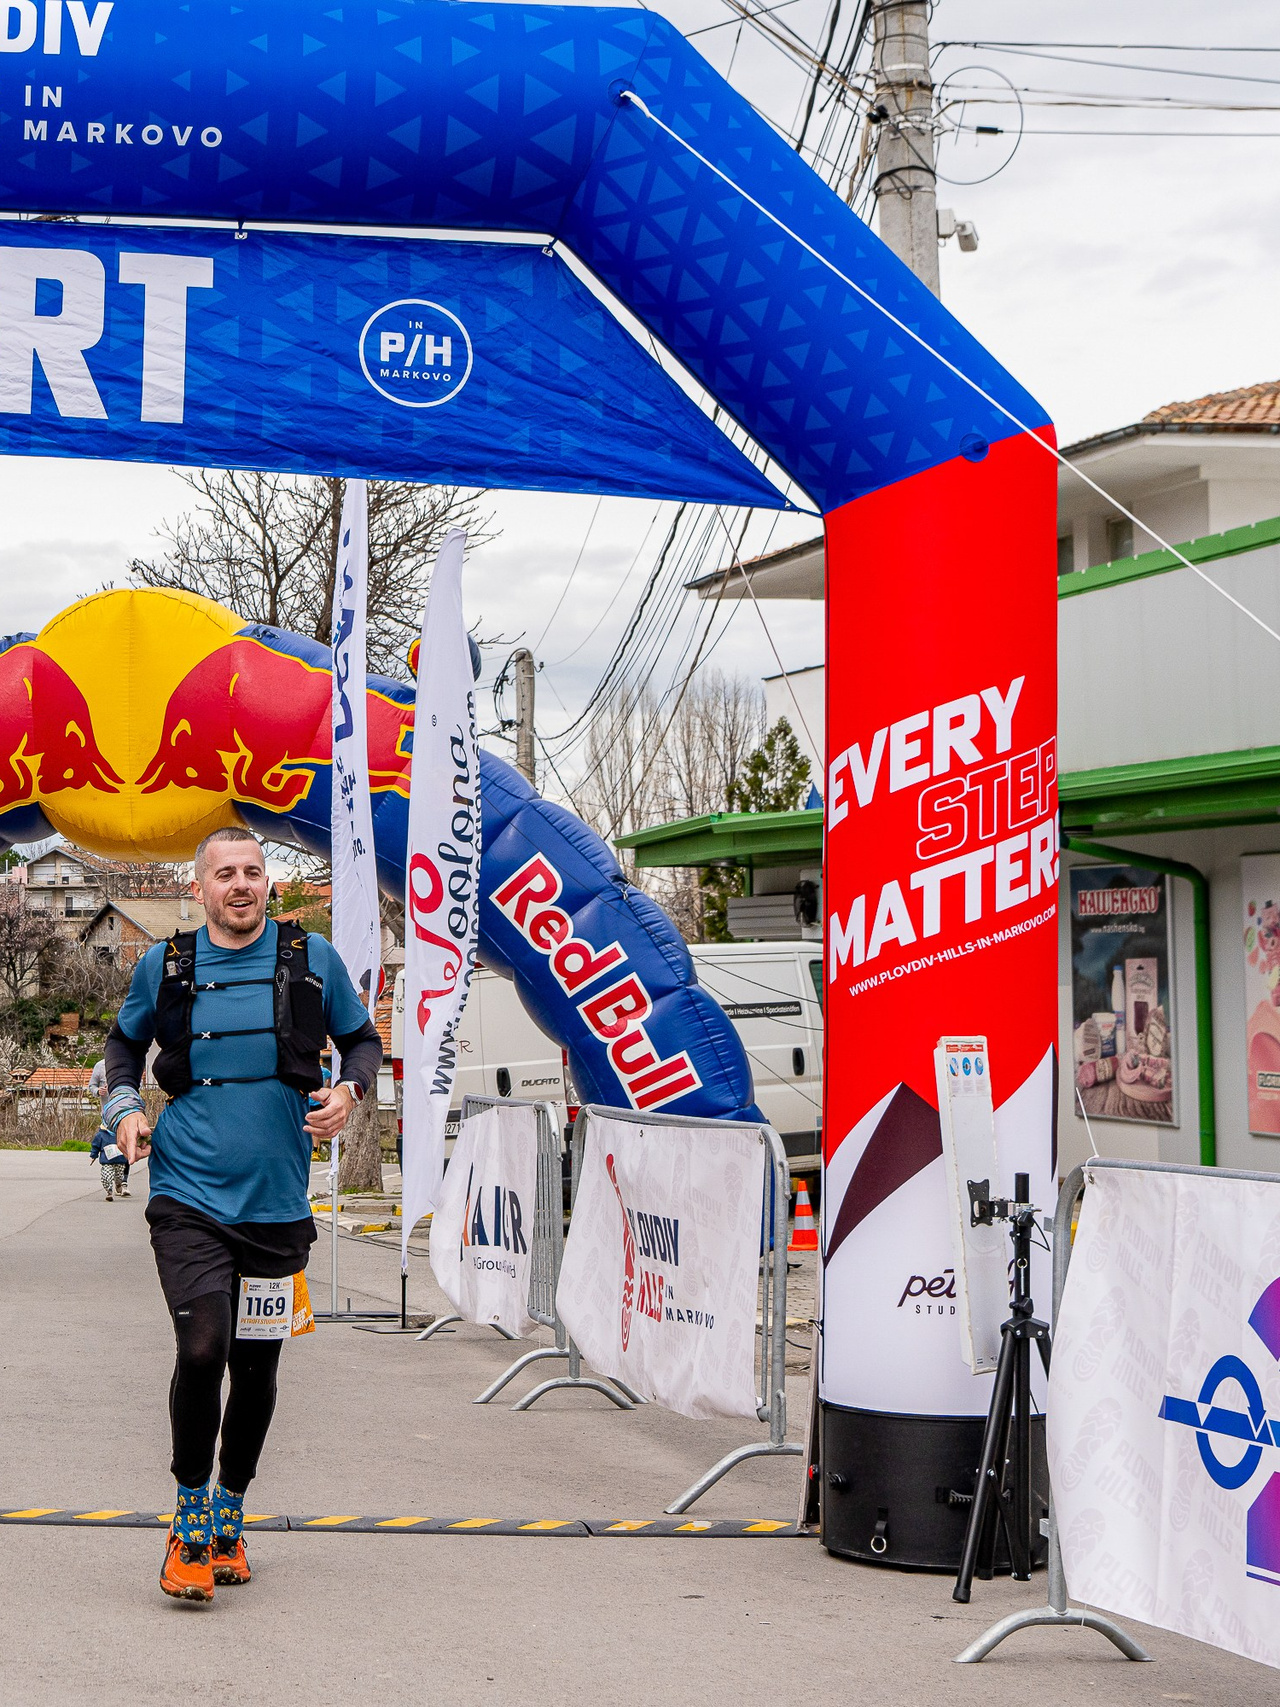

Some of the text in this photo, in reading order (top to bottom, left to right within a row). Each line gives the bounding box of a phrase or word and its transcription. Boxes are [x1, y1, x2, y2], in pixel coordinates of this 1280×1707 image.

[24, 85, 62, 108] IN
[23, 120, 223, 148] MARKOVO
[408, 320, 423, 330] IN
[380, 331, 452, 367] P/H
[380, 368, 452, 382] MARKOVO
[828, 675, 1026, 833] EVERY
[916, 735, 1057, 861] STEP
[829, 809, 1060, 985] MATTER
[494, 857, 623, 993] Red
[849, 903, 1057, 997] WWW.PLOVDIV-HILLS-IN-MARKOVO.COM
[581, 977, 697, 1111] Bull
[521, 1077, 560, 1087] DUCATO
[246, 1296, 286, 1317] 1169
[665, 1284, 674, 1300] IN
